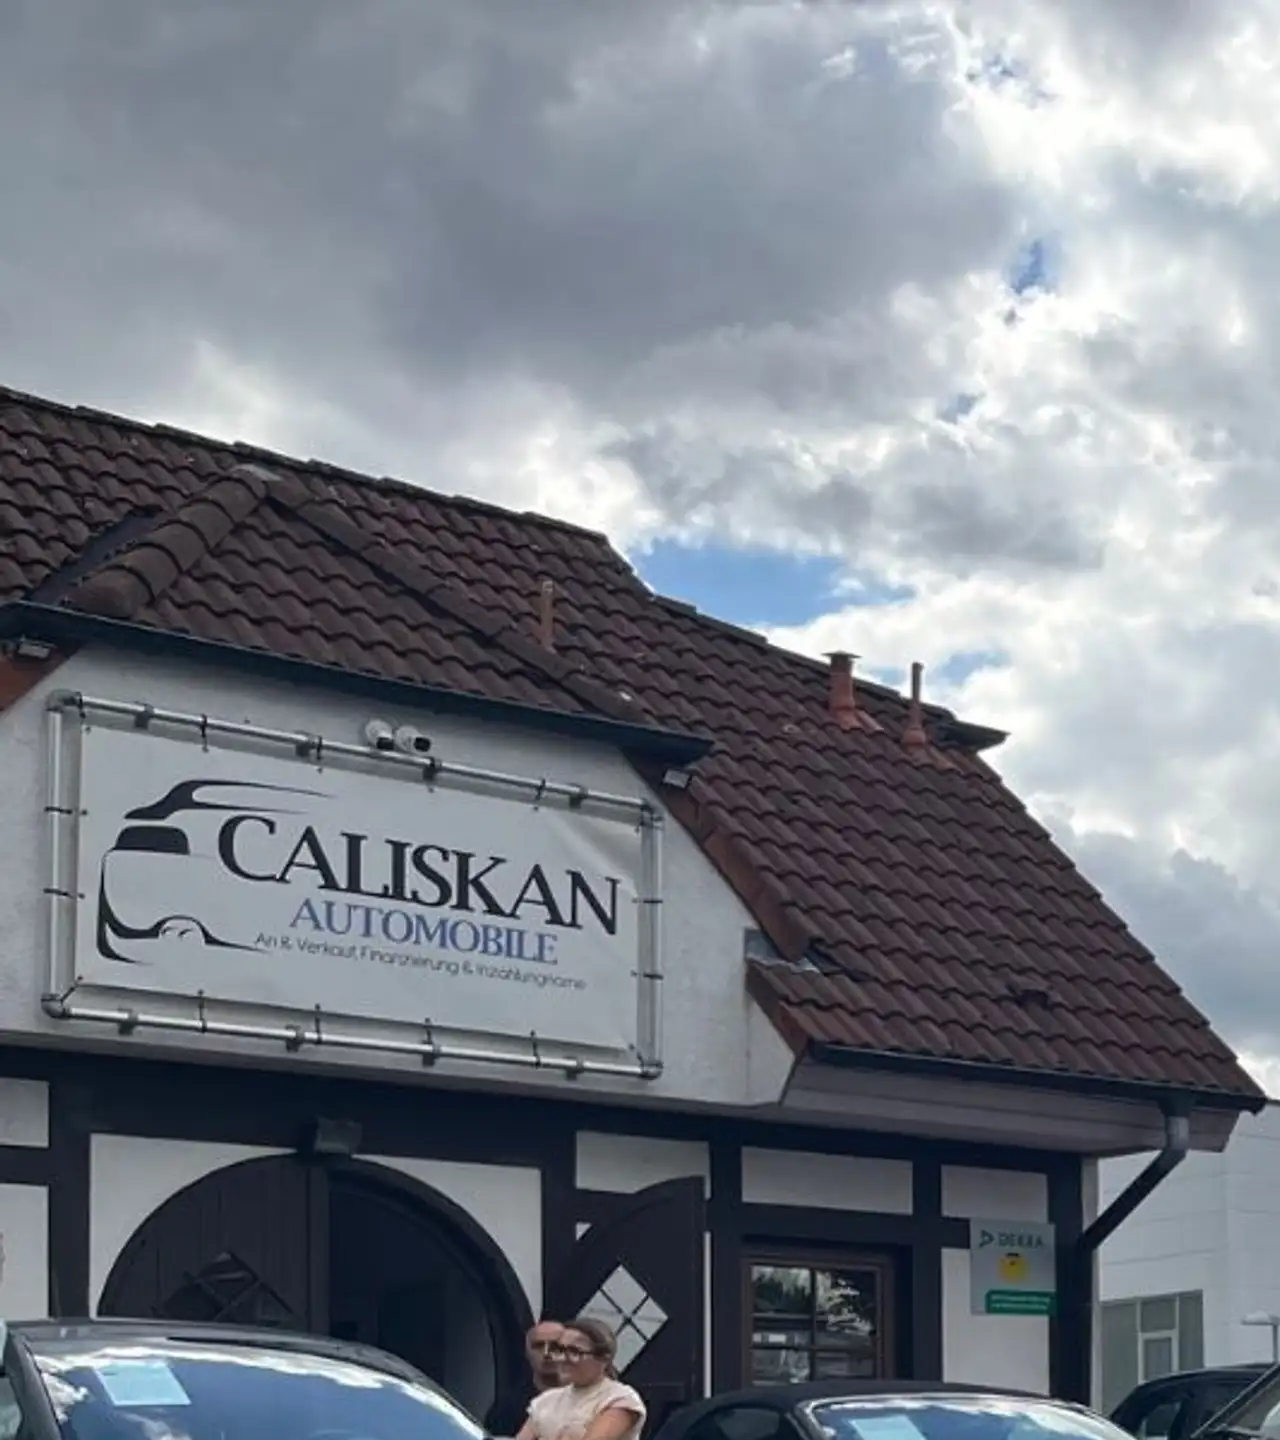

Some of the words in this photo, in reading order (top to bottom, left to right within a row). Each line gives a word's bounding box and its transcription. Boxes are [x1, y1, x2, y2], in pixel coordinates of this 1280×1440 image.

[218, 813, 622, 936] CALISKAN
[254, 931, 278, 949] An
[289, 897, 558, 967] AUTOMOBILE
